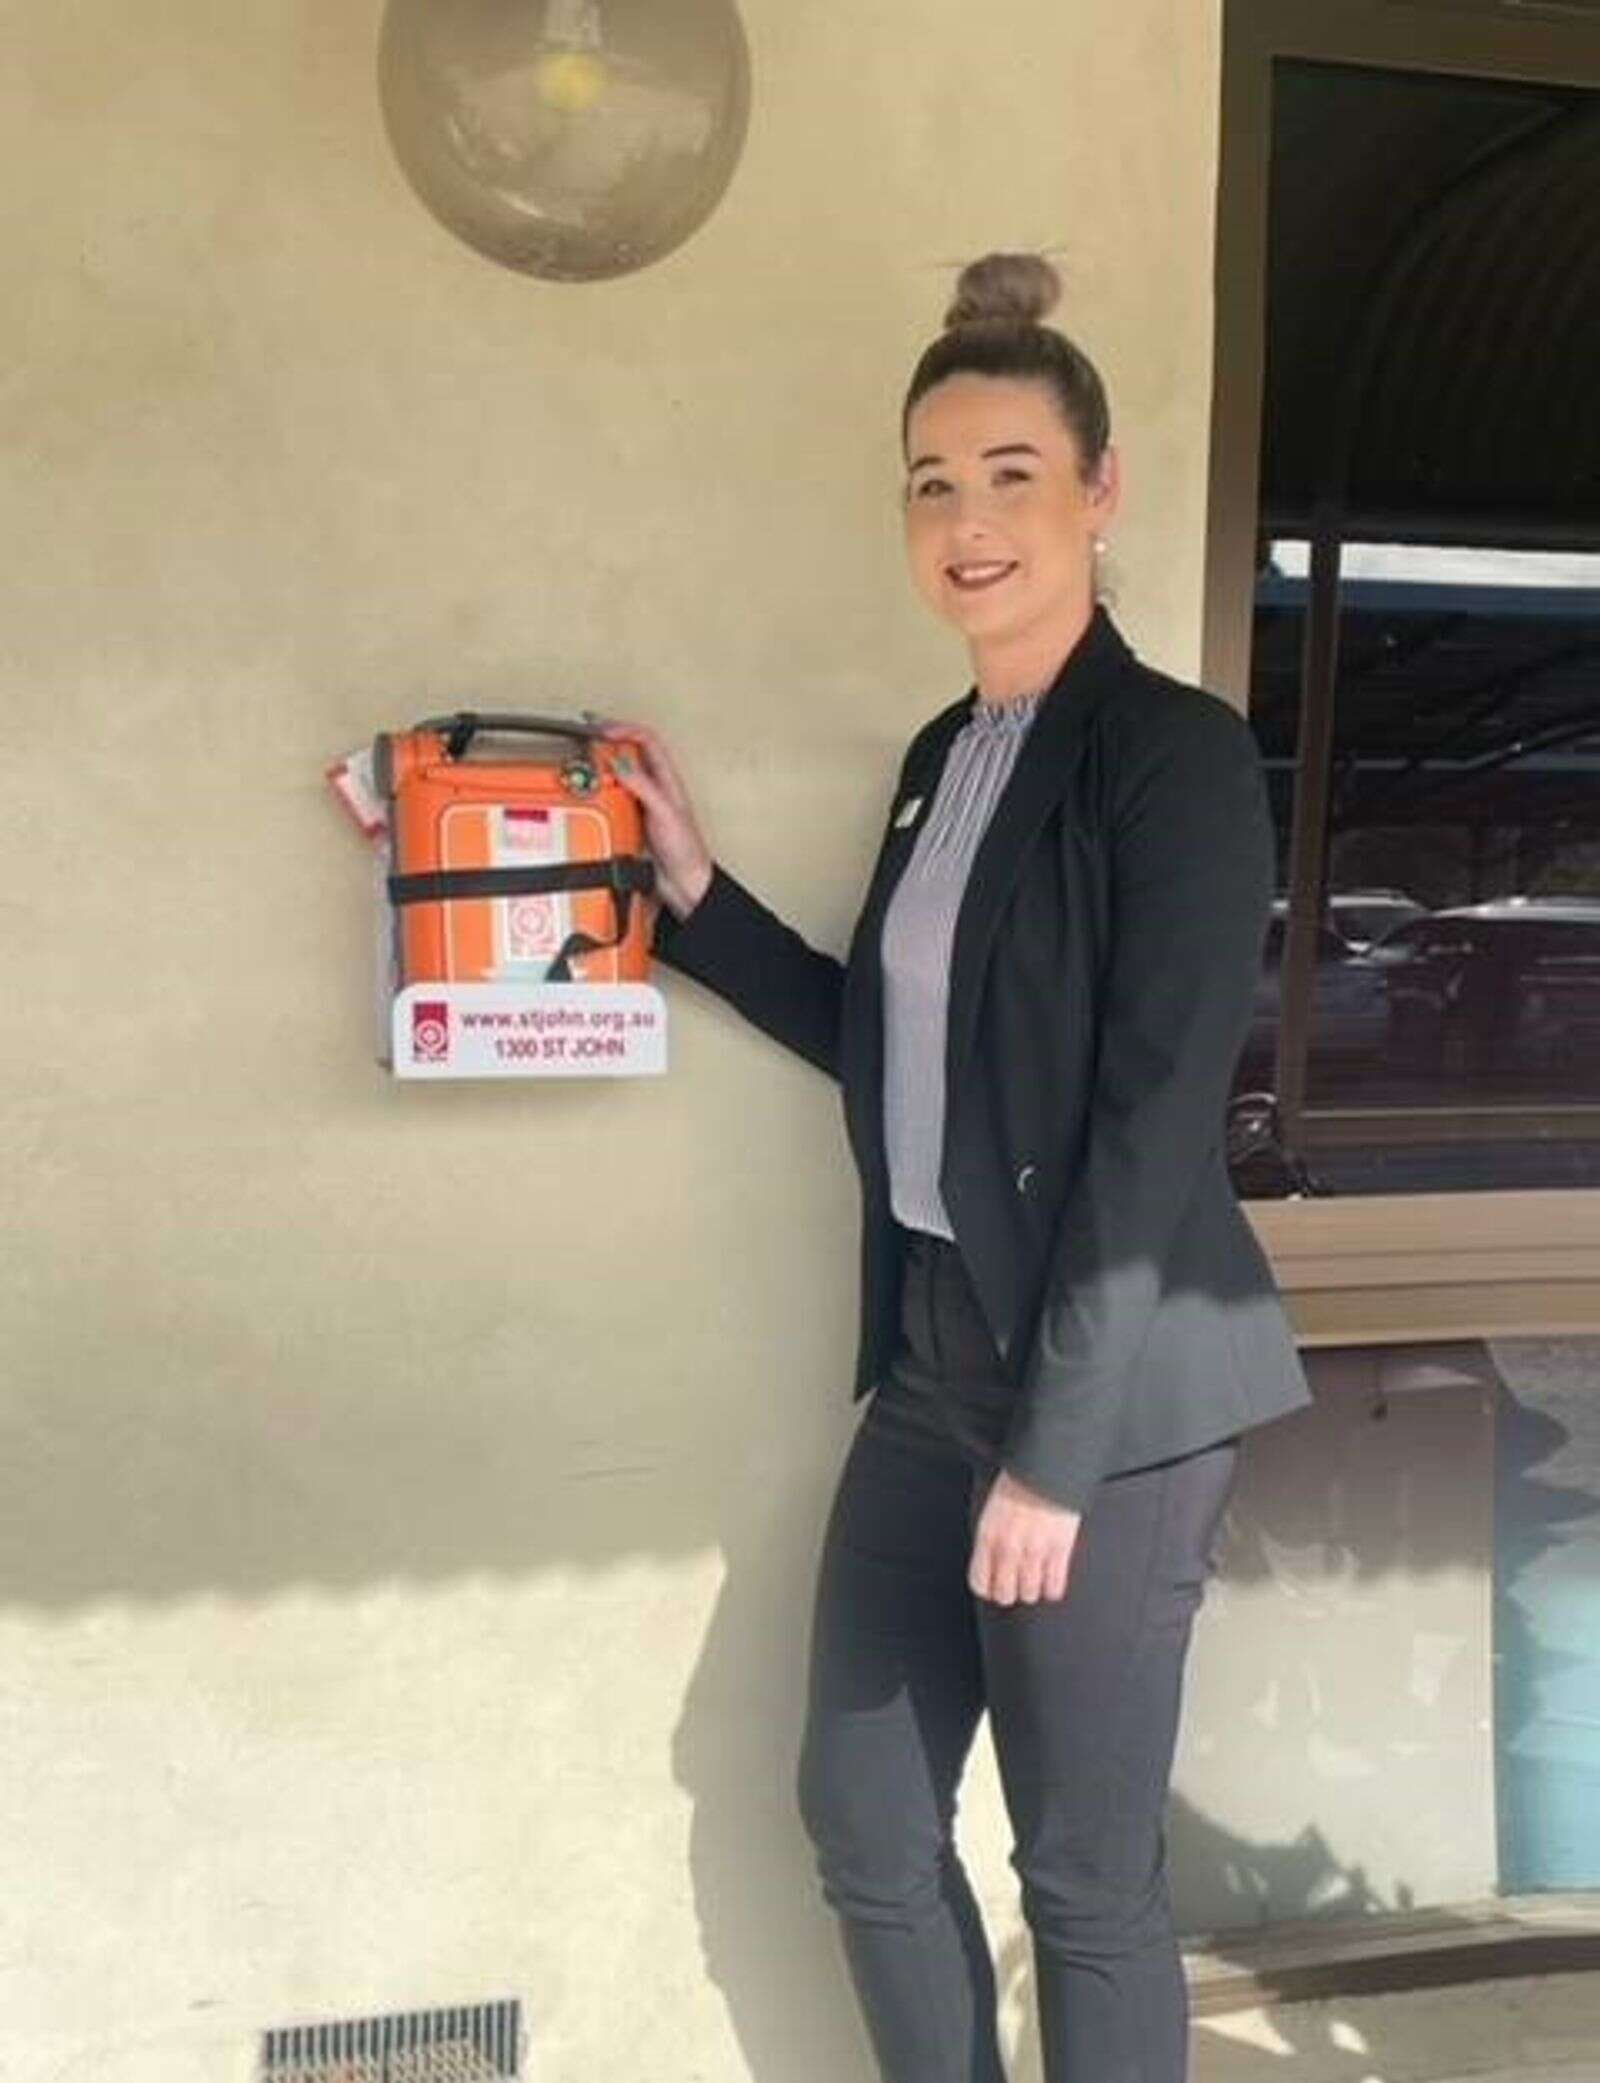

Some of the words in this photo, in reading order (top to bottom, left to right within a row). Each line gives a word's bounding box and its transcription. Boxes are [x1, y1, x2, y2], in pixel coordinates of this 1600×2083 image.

[461, 1009, 655, 1032] www.stjohn.org.au
[495, 1038, 538, 1058] 1300
[543, 1037, 566, 1058] ST
[571, 1037, 626, 1058] JOHN
